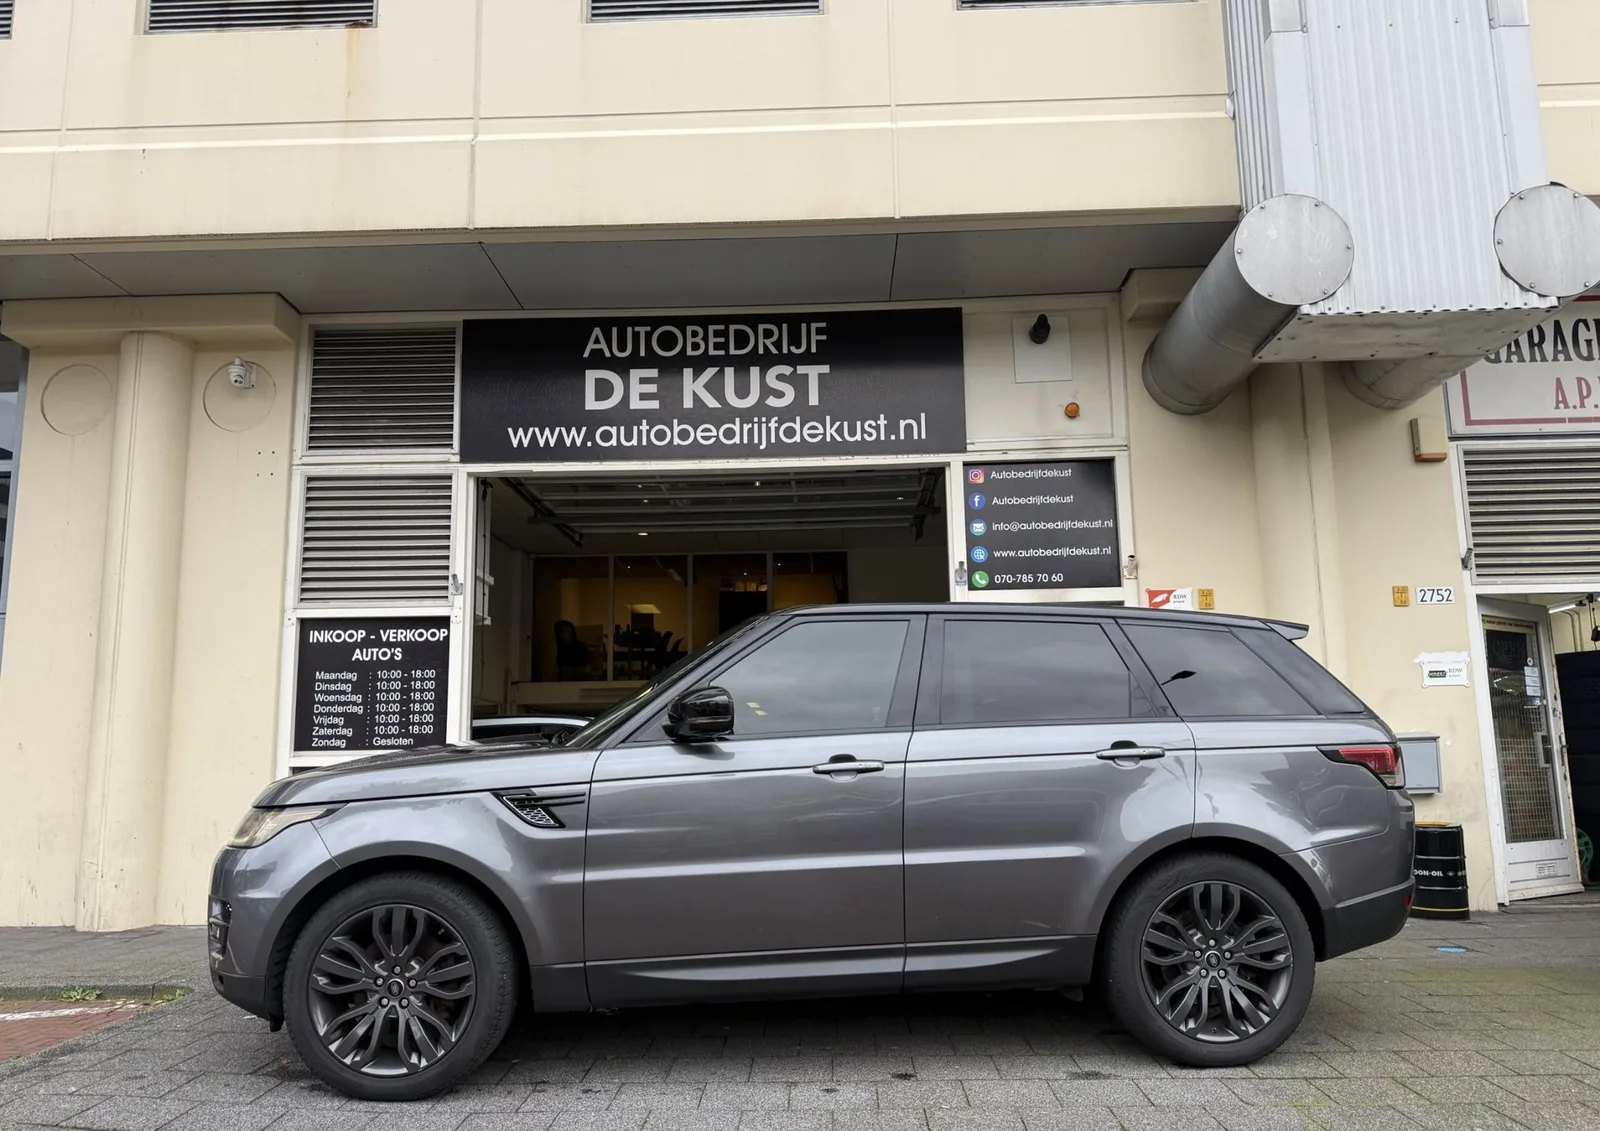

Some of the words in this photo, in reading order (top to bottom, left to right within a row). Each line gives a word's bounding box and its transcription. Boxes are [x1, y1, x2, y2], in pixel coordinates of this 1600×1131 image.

[583, 323, 826, 357] AUTOBEDRIJF
[1484, 318, 1600, 364] ARAG
[585, 369, 659, 410] DE
[683, 365, 829, 408] KUST
[1554, 375, 1600, 409] A.P.
[508, 413, 926, 449] www.autobedrijfdekust.nl
[991, 469, 1071, 479] Autobedrijfdekust
[992, 495, 1073, 505] Autobedrijfdekust
[993, 520, 1112, 531] info@autobedrijfdekust.nl
[994, 547, 1111, 557] www.autobedrijfdekust.nl
[995, 574, 1033, 583] 070-785
[1037, 574, 1048, 582] 70
[1051, 574, 1063, 582] 60
[1420, 589, 1452, 602] 2752
[310, 630, 365, 642] INKOOP
[380, 629, 448, 641] VERKOOP
[352, 648, 402, 661] AUTO'S
[316, 671, 357, 681] Maandag
[377, 670, 401, 679] 10:00
[411, 670, 436, 679] 18:00
[315, 682, 351, 692] Dinsdag
[376, 682, 401, 690] 10:00
[410, 681, 435, 690] 18:00
[314, 693, 362, 703] Woensdag
[376, 693, 400, 701] 10:00
[410, 692, 435, 701] 18:00
[314, 704, 363, 714] Donderdag
[375, 704, 400, 712] 10:00
[409, 703, 434, 712] 18:00
[313, 716, 344, 725] Vrijdag
[374, 715, 399, 723] 10:00
[409, 714, 434, 723] 18:00
[312, 727, 352, 736] Zaterdag
[374, 726, 399, 734] 10:00
[408, 726, 433, 734] 18:00
[312, 738, 346, 748] Zondag
[373, 737, 414, 746] Gesloten
